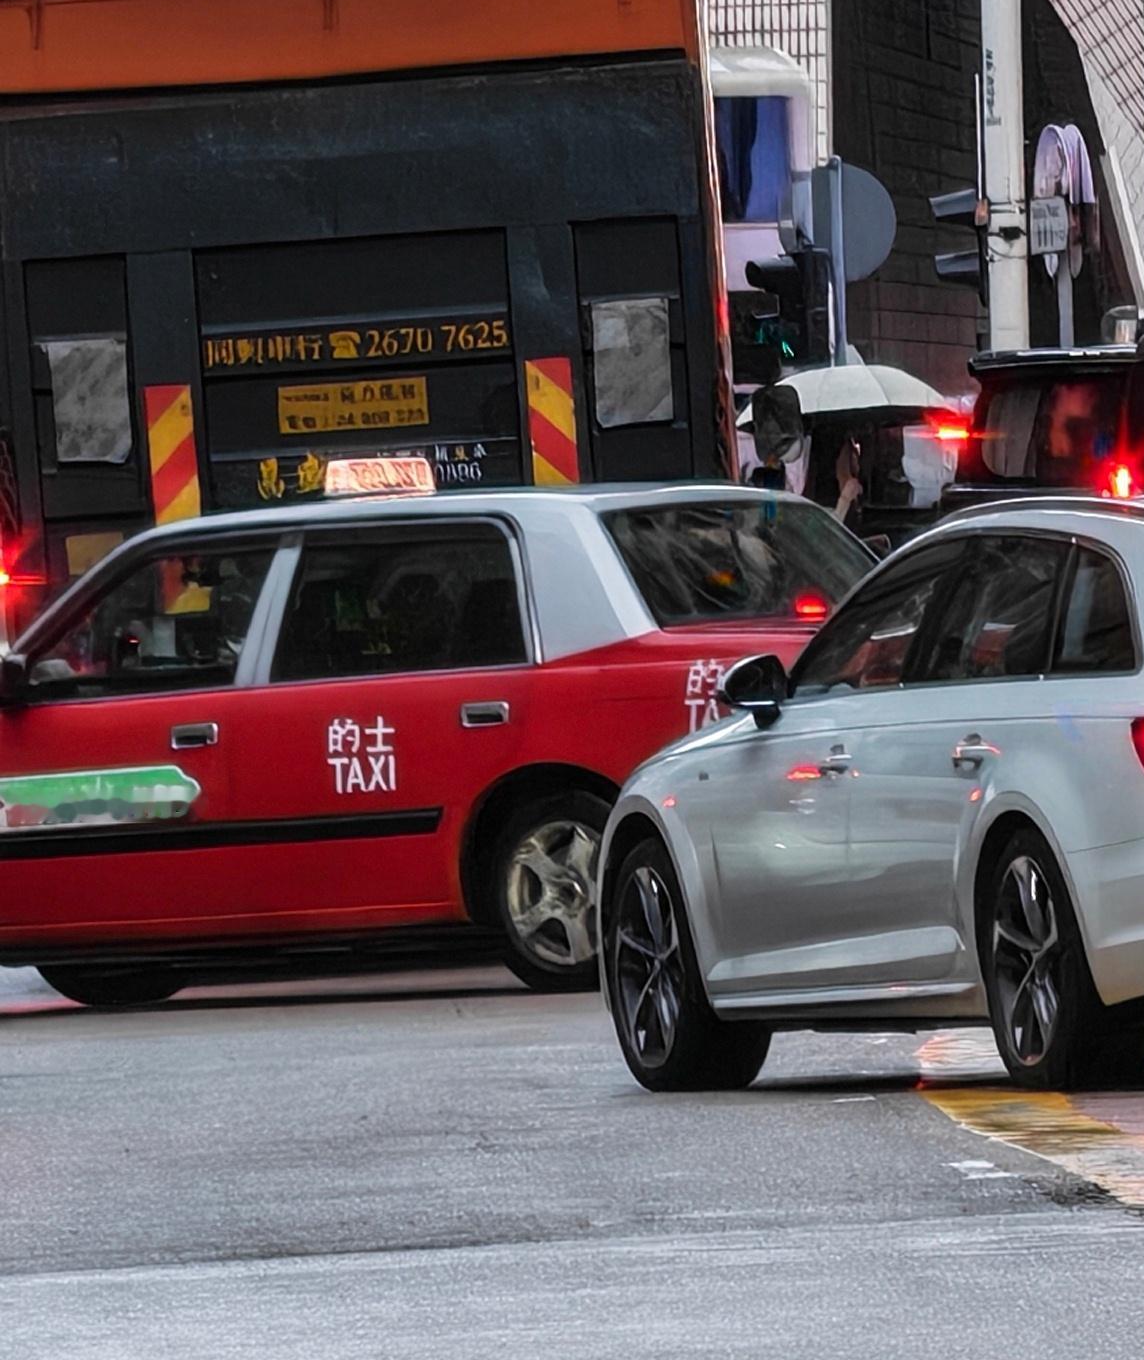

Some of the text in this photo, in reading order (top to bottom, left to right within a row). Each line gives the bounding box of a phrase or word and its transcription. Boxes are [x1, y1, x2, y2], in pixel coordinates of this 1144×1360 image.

[366, 327, 433, 358] 2670
[440, 320, 509, 352] 7625
[686, 658, 726, 697] 的
[327, 715, 397, 754] 的士
[684, 698, 722, 733] TA
[326, 754, 397, 795] TAXI
